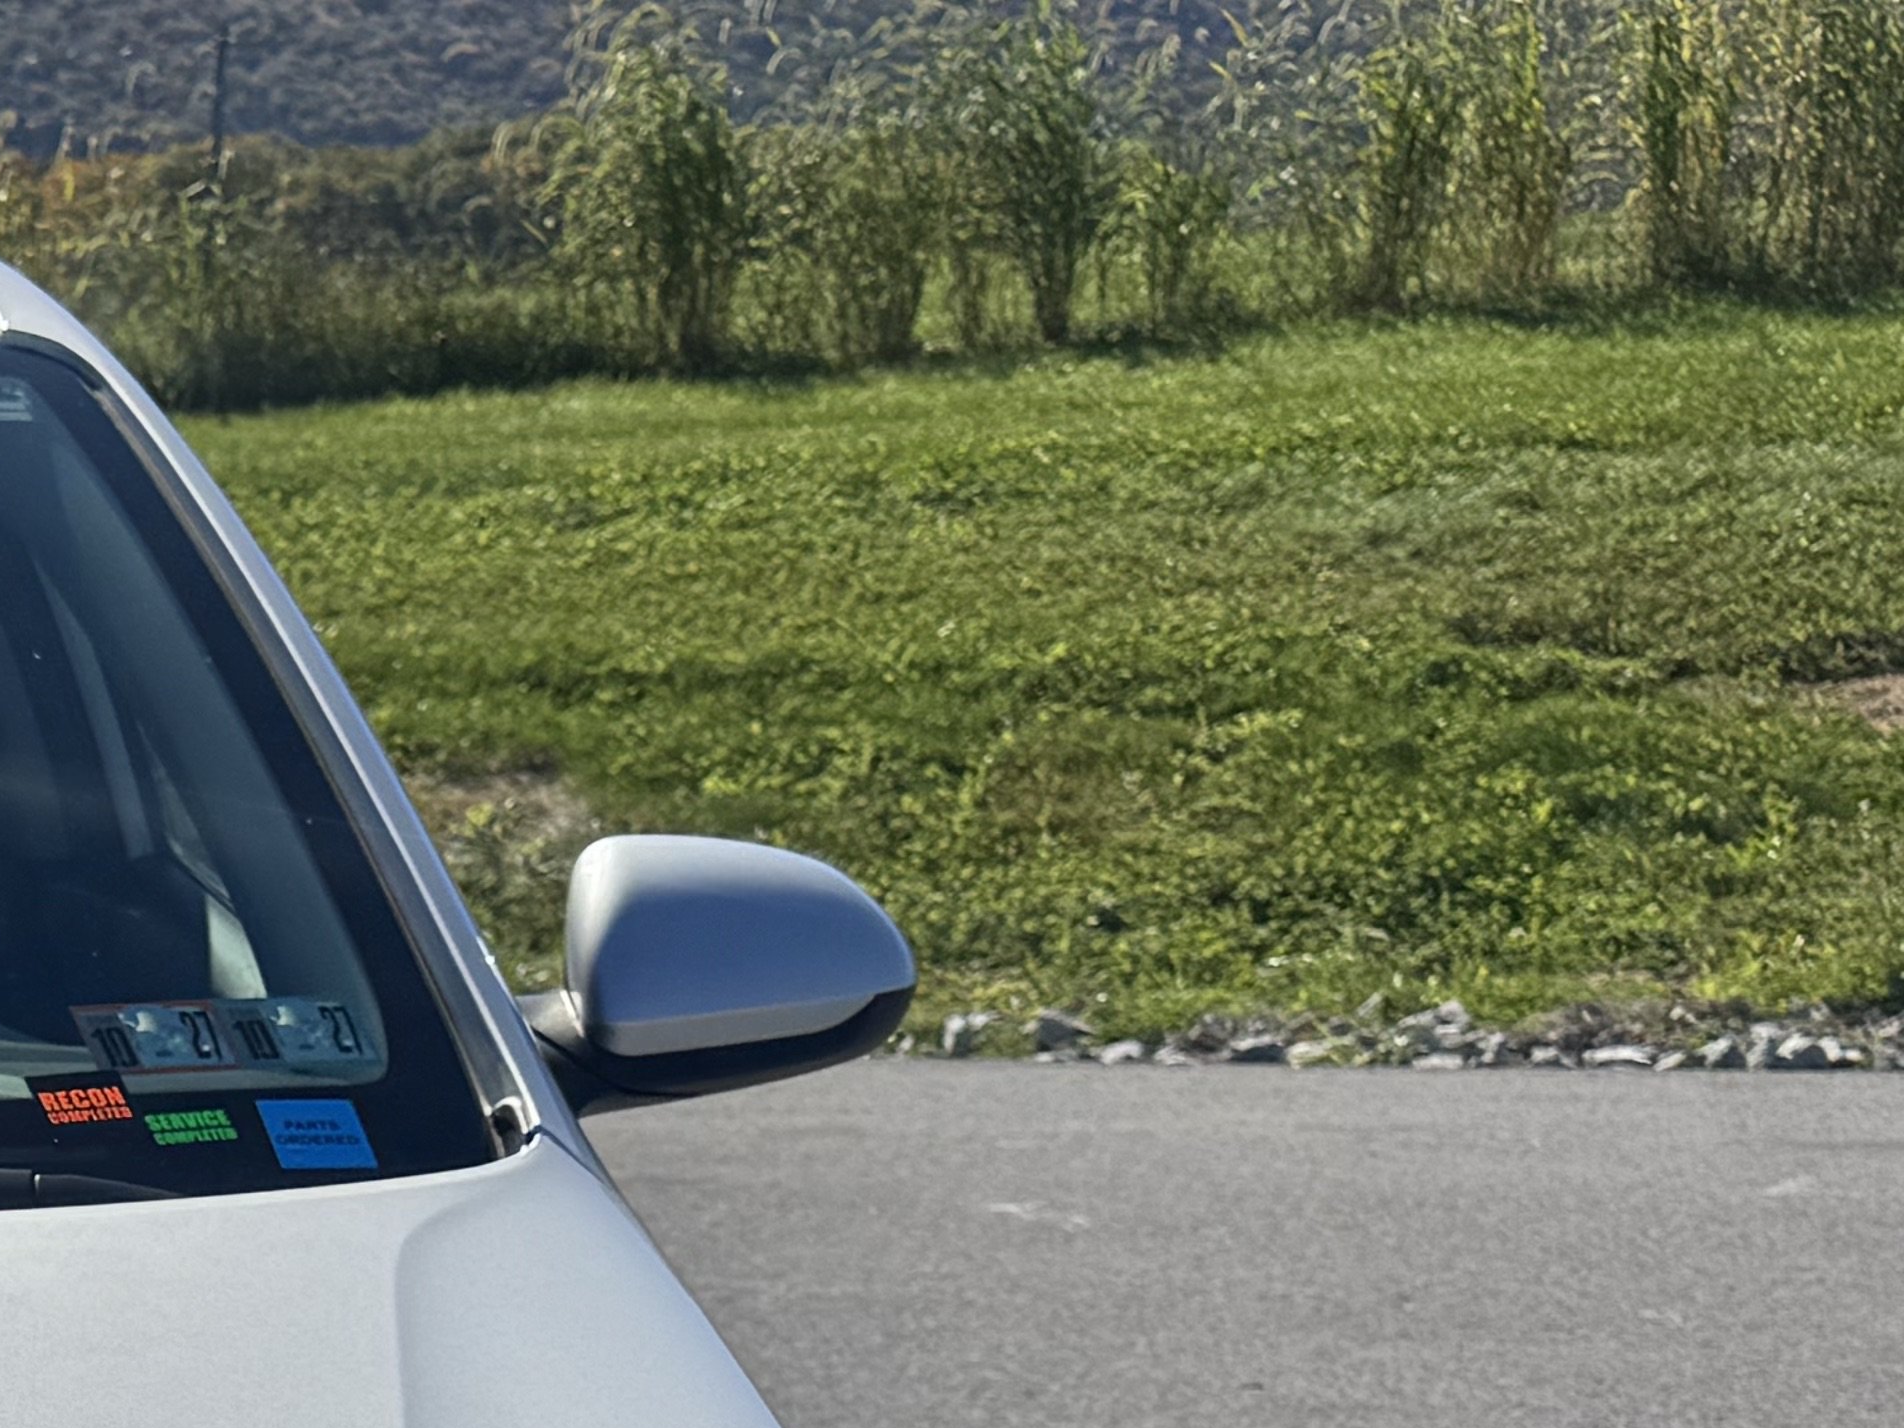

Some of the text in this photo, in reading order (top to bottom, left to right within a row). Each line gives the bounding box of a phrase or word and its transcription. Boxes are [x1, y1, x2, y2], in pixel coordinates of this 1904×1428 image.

[91, 1011, 223, 1068] 10 27
[234, 1006, 363, 1060] 10 27
[38, 1086, 126, 1112] RECON
[48, 1107, 133, 1125] COMPLETED
[145, 1109, 231, 1131] SERVICE
[154, 1127, 238, 1146] COMPLETED
